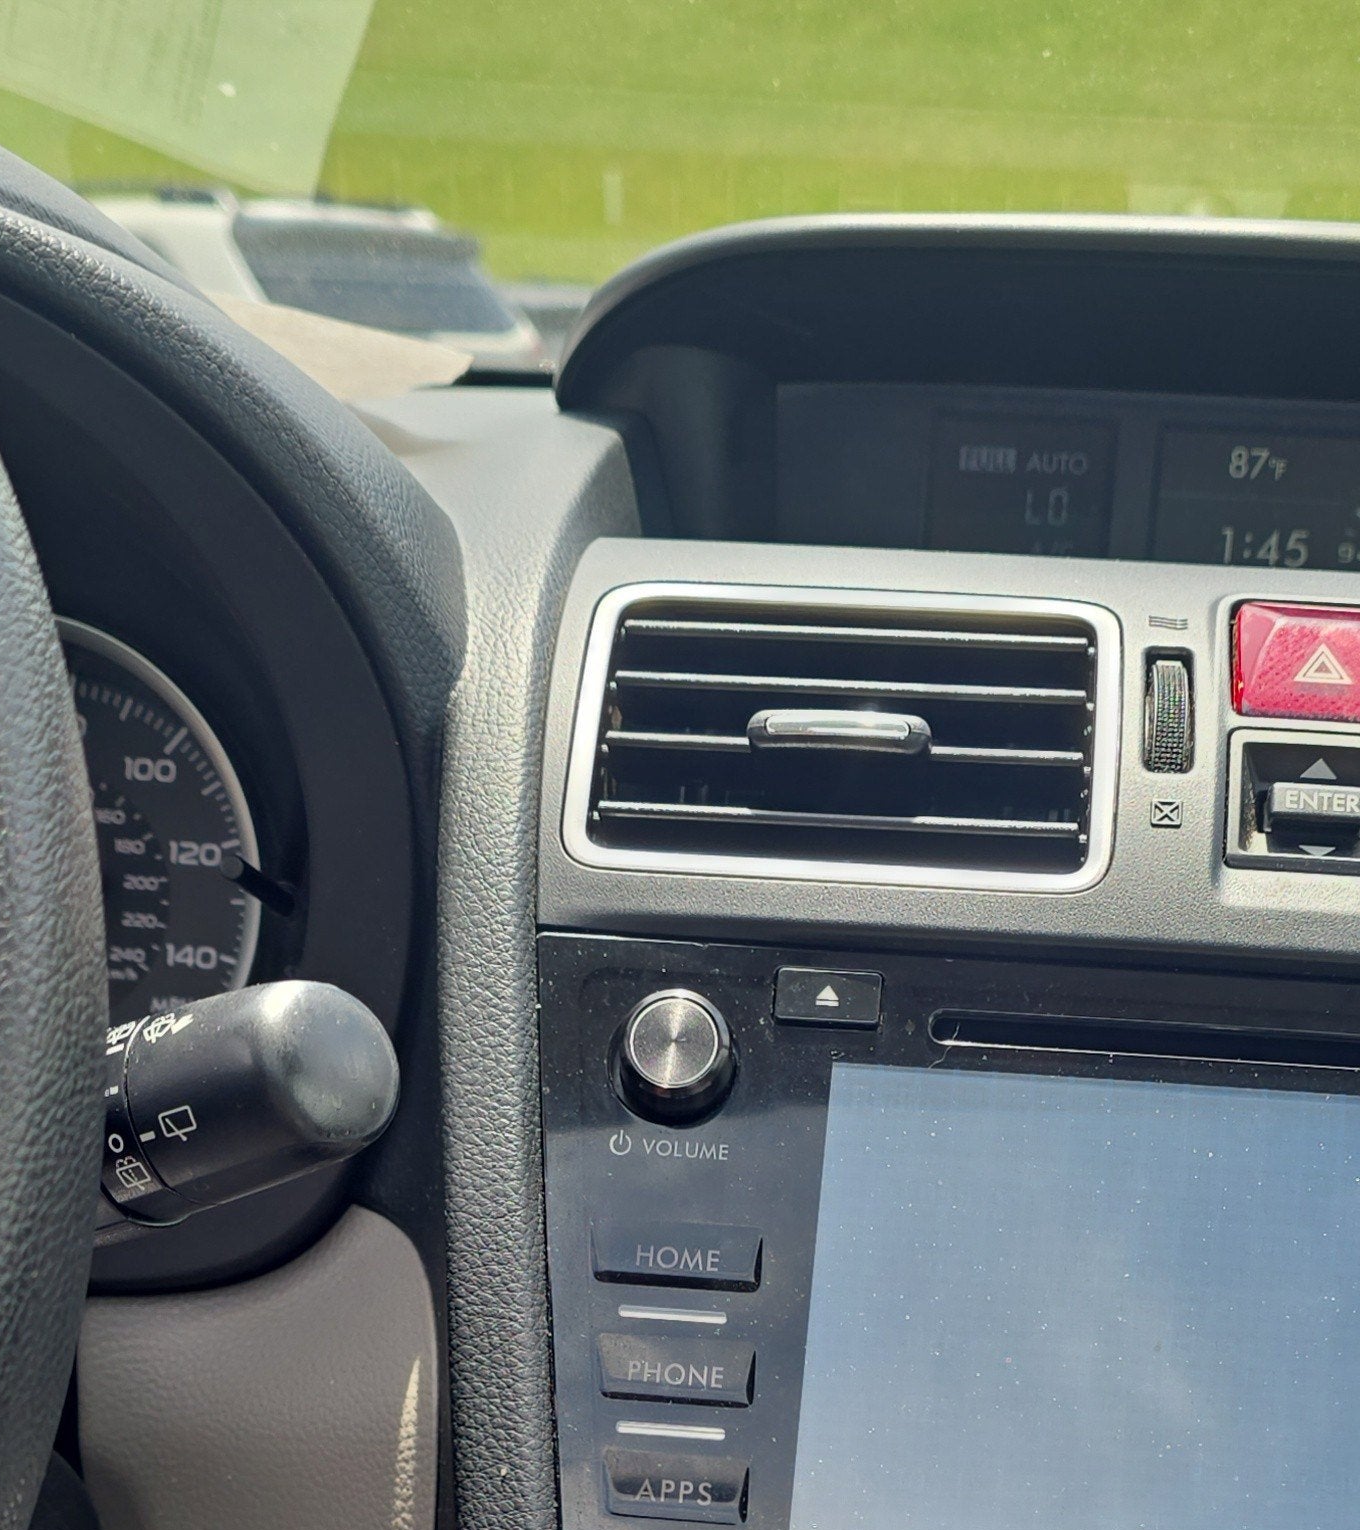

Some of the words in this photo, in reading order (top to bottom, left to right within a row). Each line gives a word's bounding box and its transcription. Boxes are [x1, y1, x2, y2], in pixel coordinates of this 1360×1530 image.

[1026, 450, 1088, 475] AUTO
[1222, 527, 1311, 567] 1:45
[124, 757, 177, 783] 100
[1284, 789, 1360, 813] ENTER
[169, 841, 221, 866] 120
[123, 874, 159, 891] 200
[121, 912, 158, 929] 220
[165, 943, 217, 969] 140
[642, 1138, 729, 1160] VOLUME
[635, 1244, 720, 1272] HOME
[628, 1360, 724, 1389] PHONE
[635, 1477, 713, 1507] APPS
